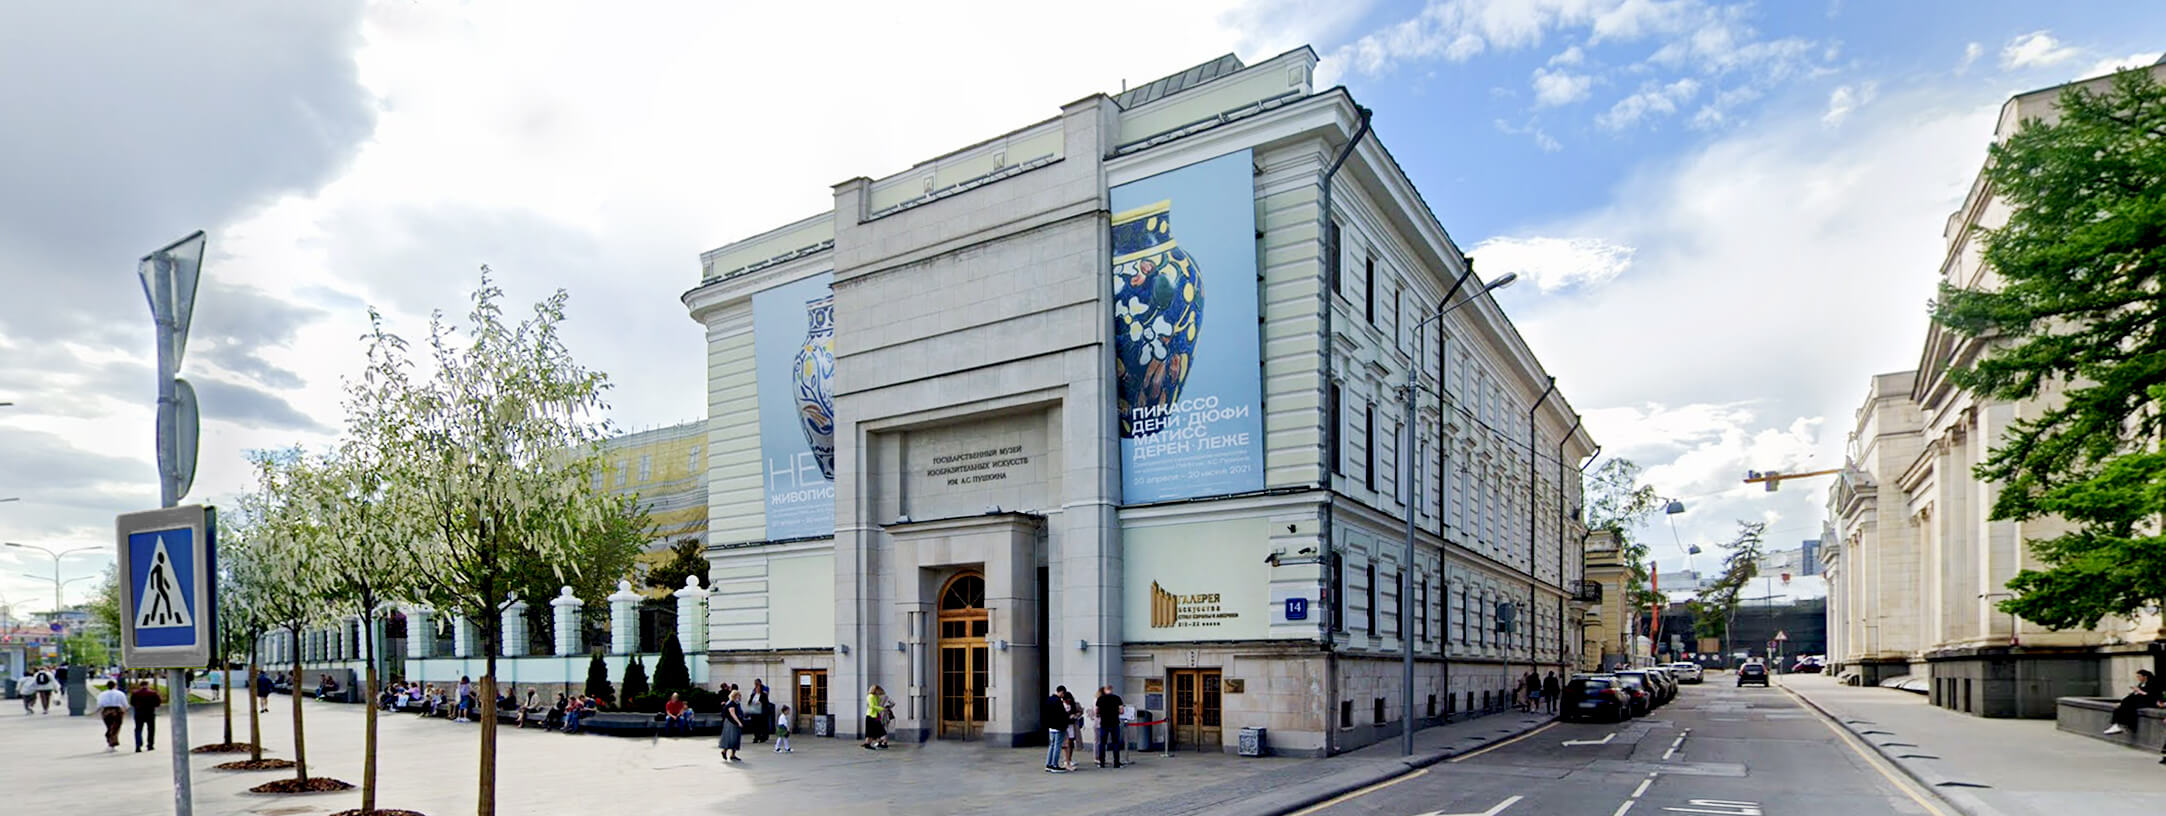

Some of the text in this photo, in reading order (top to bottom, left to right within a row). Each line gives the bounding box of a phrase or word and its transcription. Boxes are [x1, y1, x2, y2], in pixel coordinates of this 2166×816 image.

[1132, 395, 1218, 420] ПИКАССО
[1132, 404, 1249, 436] ДЕНИ ДЮФИ
[1133, 425, 1208, 447] МАТИСС
[1133, 432, 1249, 460] ДЕРЕН ЛЕЖЕ
[999, 445, 1022, 455] МУЗЕЙ
[1178, 594, 1220, 604] ГАЛЕРЕЯ
[1289, 602, 1301, 612] 14
